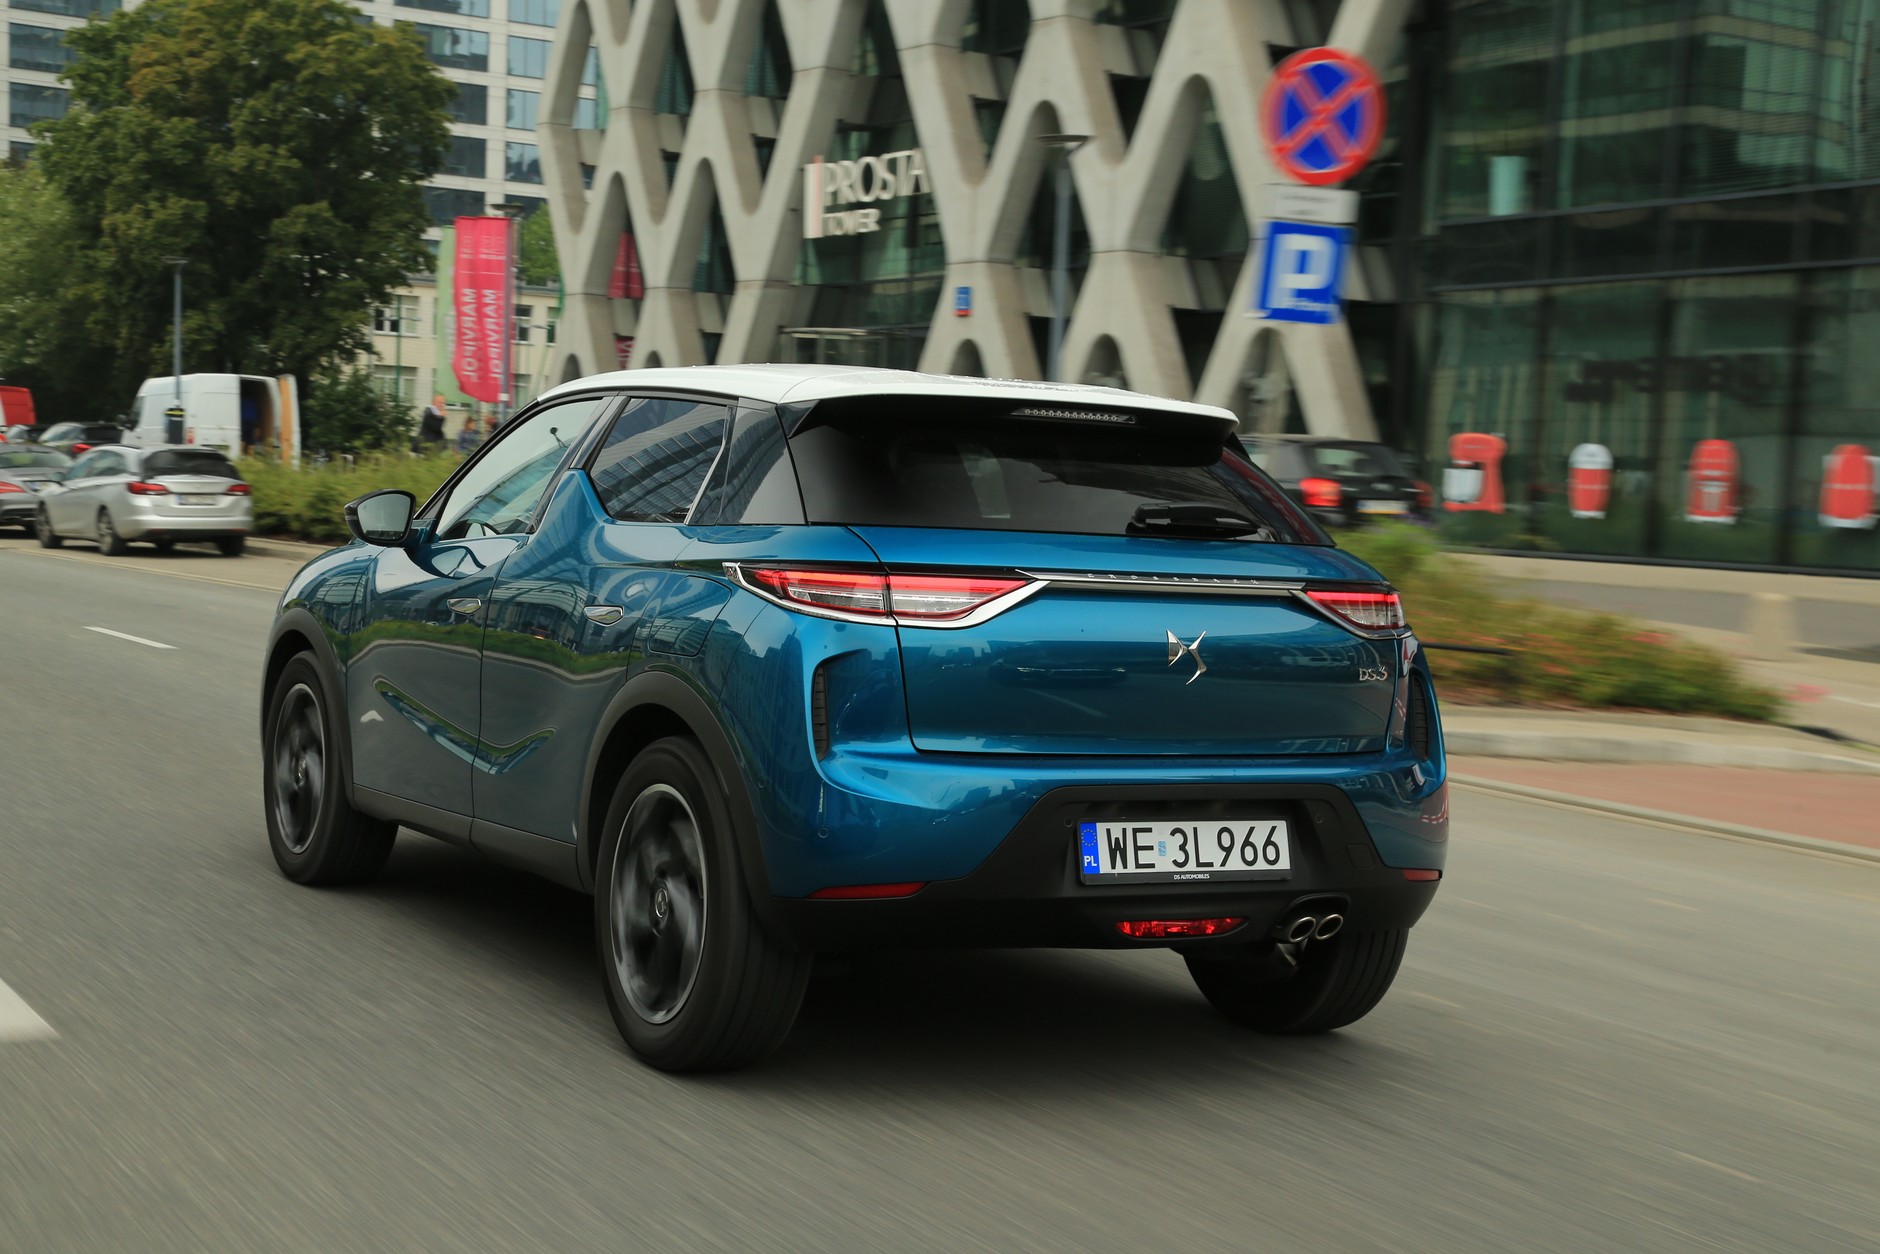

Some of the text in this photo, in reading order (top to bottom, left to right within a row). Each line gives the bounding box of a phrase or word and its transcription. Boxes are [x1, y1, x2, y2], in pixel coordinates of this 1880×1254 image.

[824, 149, 932, 206] PROSTA
[822, 209, 880, 236] TOWER
[1265, 233, 1337, 309] P
[1084, 855, 1098, 867] PL
[1106, 826, 1280, 870] WE 3L966
